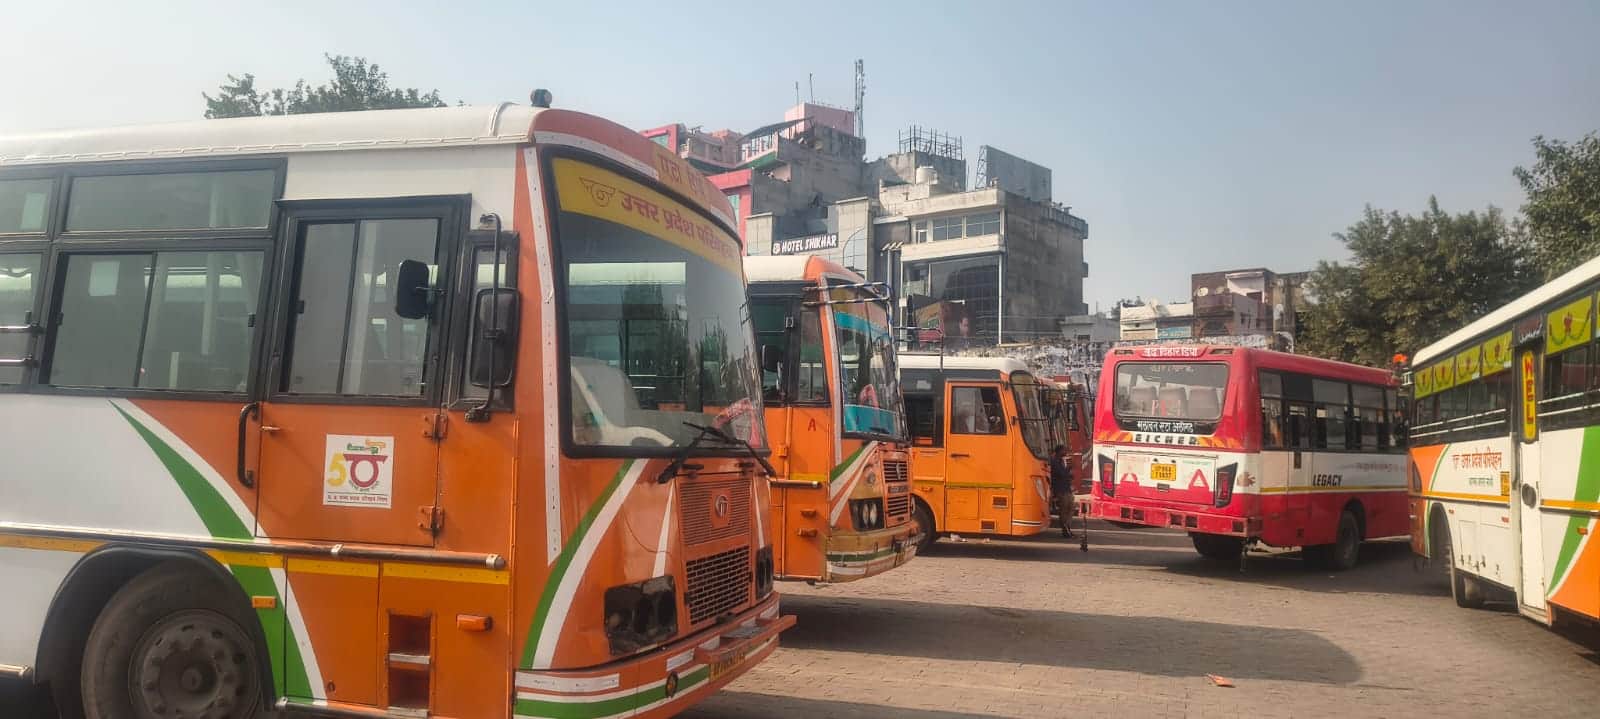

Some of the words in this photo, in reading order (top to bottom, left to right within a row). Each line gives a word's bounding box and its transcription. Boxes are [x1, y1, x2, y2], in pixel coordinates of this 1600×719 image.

[619, 190, 661, 223] उत्तर
[662, 208, 695, 240] प्रदेश
[781, 239, 804, 254] HOTEL
[804, 234, 837, 251] SHIKHAR
[807, 418, 817, 432] A
[1135, 433, 1198, 446] EICHER
[1312, 474, 1343, 487] LEGACY
